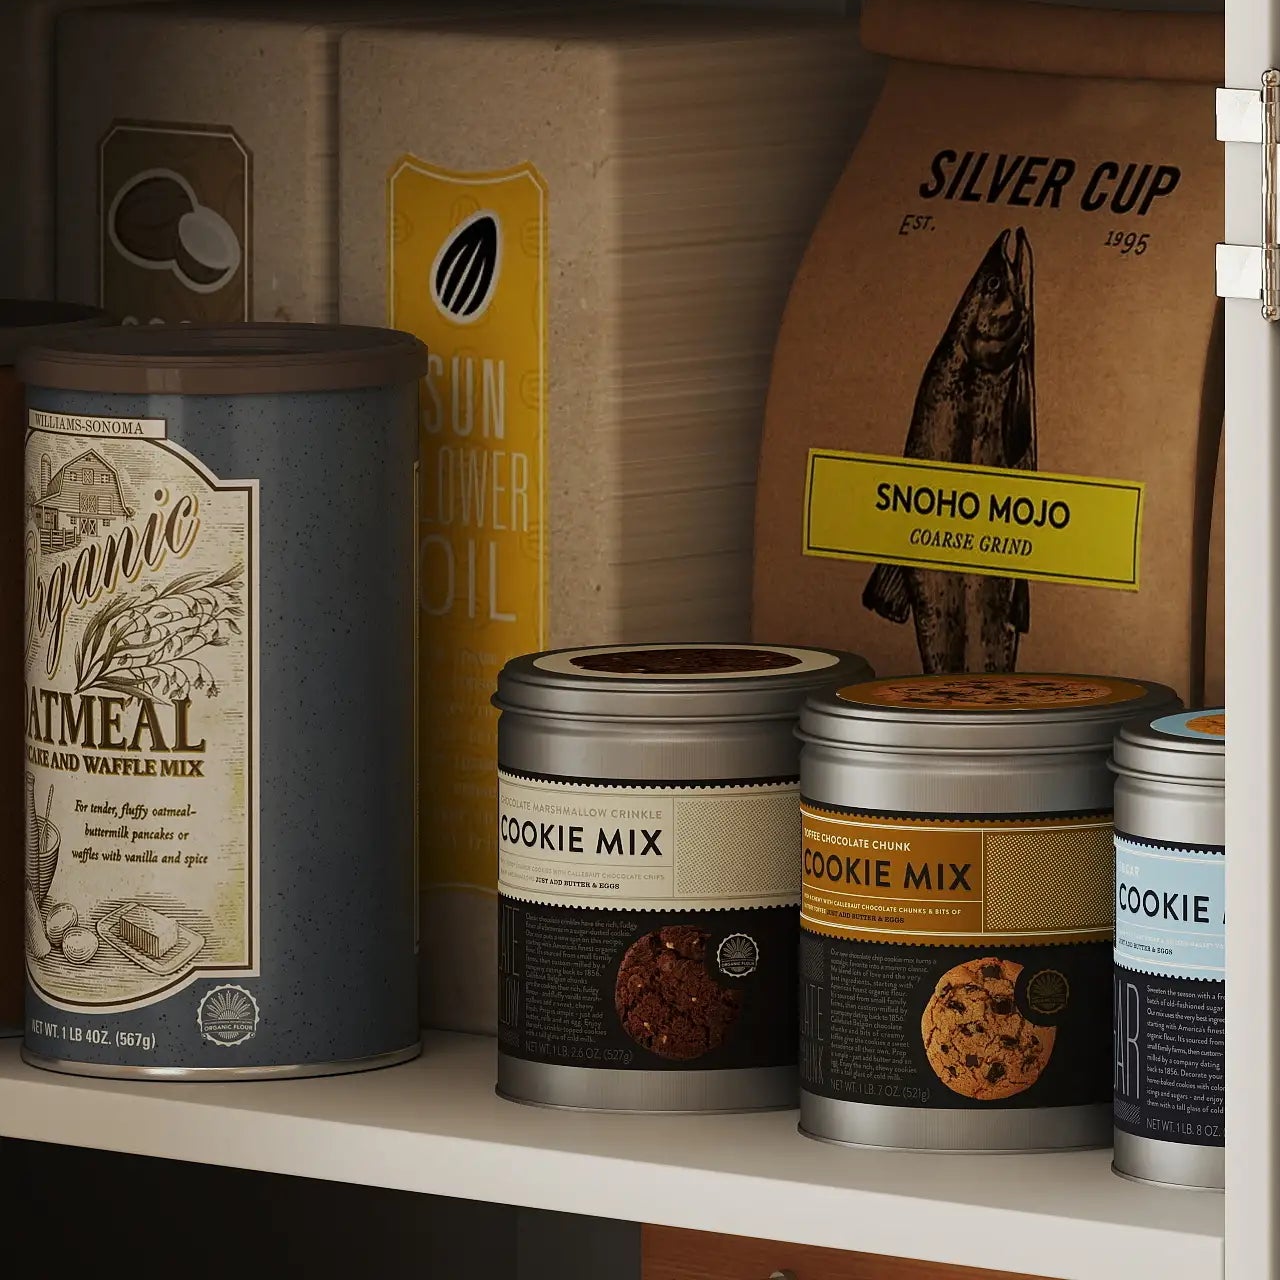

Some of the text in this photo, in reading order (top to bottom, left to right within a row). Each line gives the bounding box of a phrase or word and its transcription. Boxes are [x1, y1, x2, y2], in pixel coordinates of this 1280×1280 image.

[919, 149, 1182, 216] SILVER CUP
[1105, 230, 1150, 256] 1995
[423, 355, 507, 440] SUN
[34, 413, 144, 435] WILLIAMS-SONOMA
[875, 482, 1071, 530] SNOHO MOJO
[909, 527, 1033, 556] COARSE GRIND
[420, 535, 517, 622] OIL
[51, 752, 80, 772] AND
[83, 755, 157, 777] WAFFLE
[160, 759, 205, 778] MIX
[74, 800, 88, 813] For
[90, 801, 118, 817] tender,
[120, 802, 149, 820] fluffy
[501, 794, 662, 820] CHOCOLATE MARSHMALLOW CRINKLE
[84, 823, 189, 843] buttermilk pancakes or
[501, 815, 663, 856] COOKIE MIX
[804, 827, 911, 852] TOFFEE CHOCOLATE CHUNK
[71, 848, 209, 868] waffles with vanilla and spice
[804, 848, 972, 891] COOKIE MIX
[861, 904, 897, 913] CHOCOLATE
[899, 907, 926, 915] CHUNKS
[1119, 883, 1209, 923] COOKIE
[1206, 1005, 1224, 1014] sugar
[32, 1019, 45, 1034] NET
[45, 1022, 60, 1039] WT.
[62, 1026, 66, 1039] 1
[69, 1027, 83, 1042] LB
[115, 1031, 156, 1050] (567g)
[603, 1048, 633, 1064] (527g)
[1208, 1073, 1224, 1082] your
[831, 1079, 844, 1091] NET
[864, 1083, 876, 1095] LB.
[878, 1085, 883, 1095] 7
[885, 1085, 901, 1097] OZ.
[902, 1087, 930, 1102] (521g)
[1206, 1095, 1224, 1105] enjoy
[1147, 1118, 1221, 1137] NET WT. 1 LB. 8 OZ.
